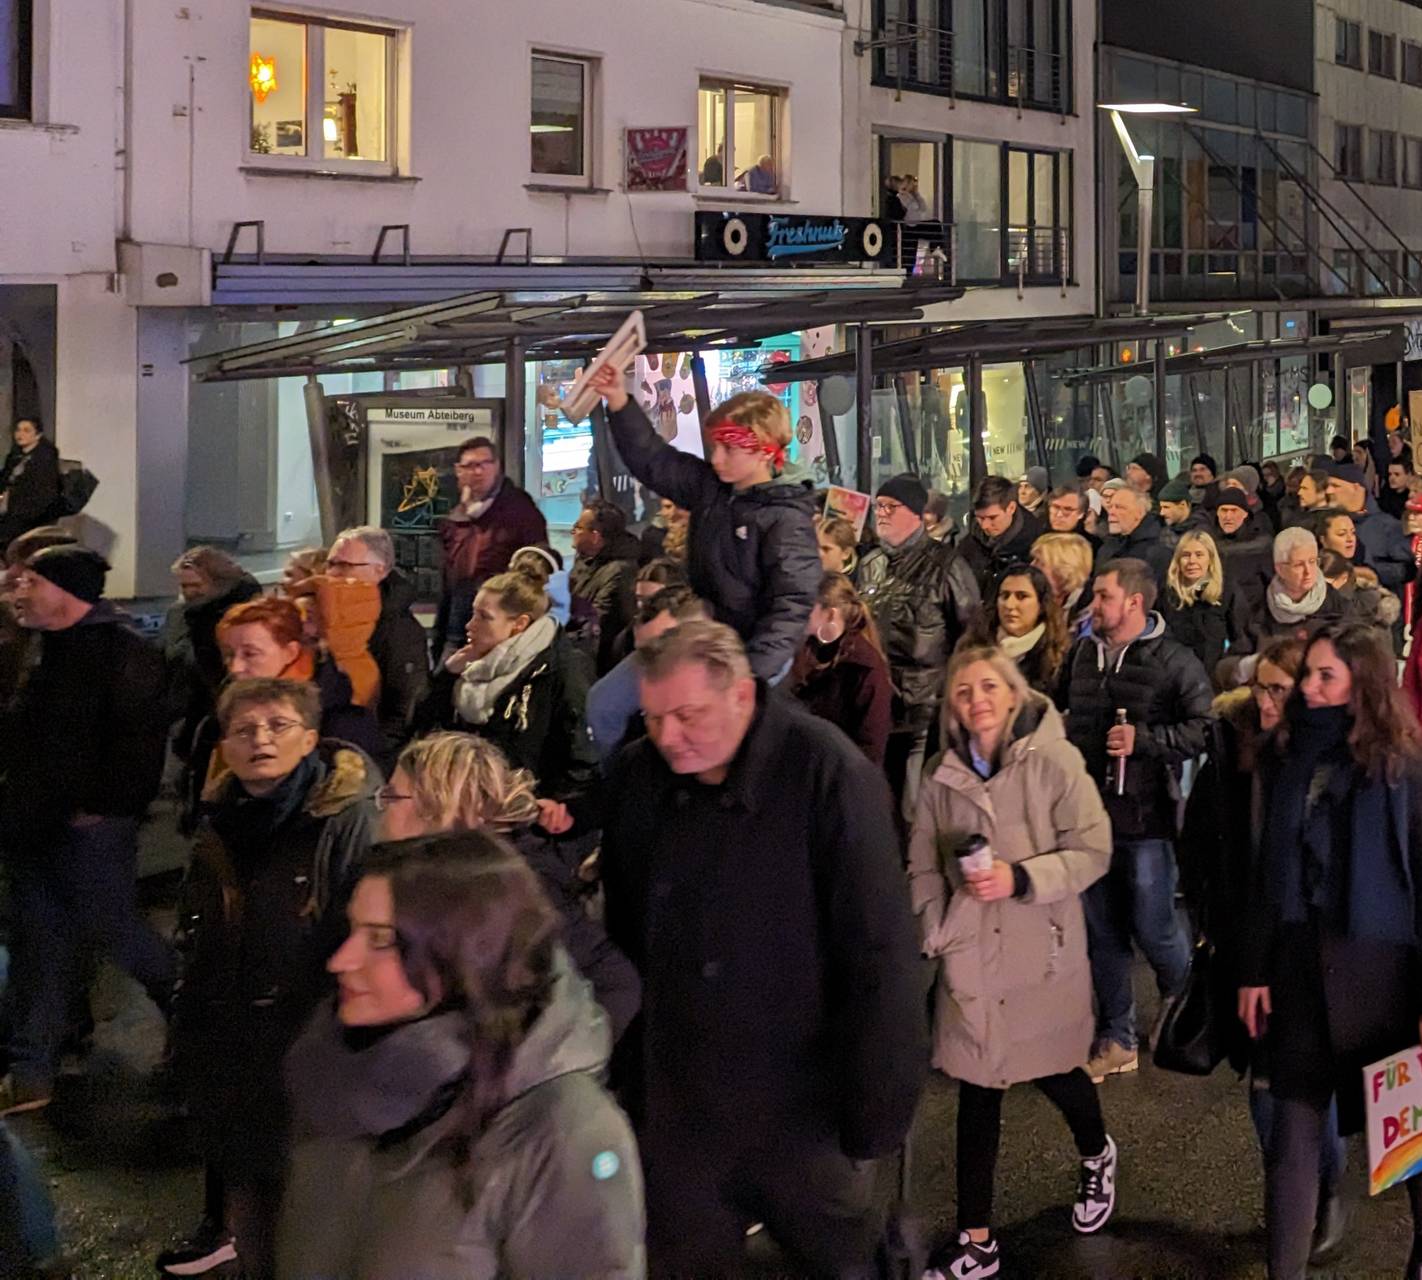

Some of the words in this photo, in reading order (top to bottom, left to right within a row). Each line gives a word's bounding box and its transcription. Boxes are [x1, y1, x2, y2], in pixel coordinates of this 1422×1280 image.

[385, 409, 425, 419] Museum
[427, 409, 475, 422] Abteiberg
[1372, 1060, 1411, 1103] FÜR
